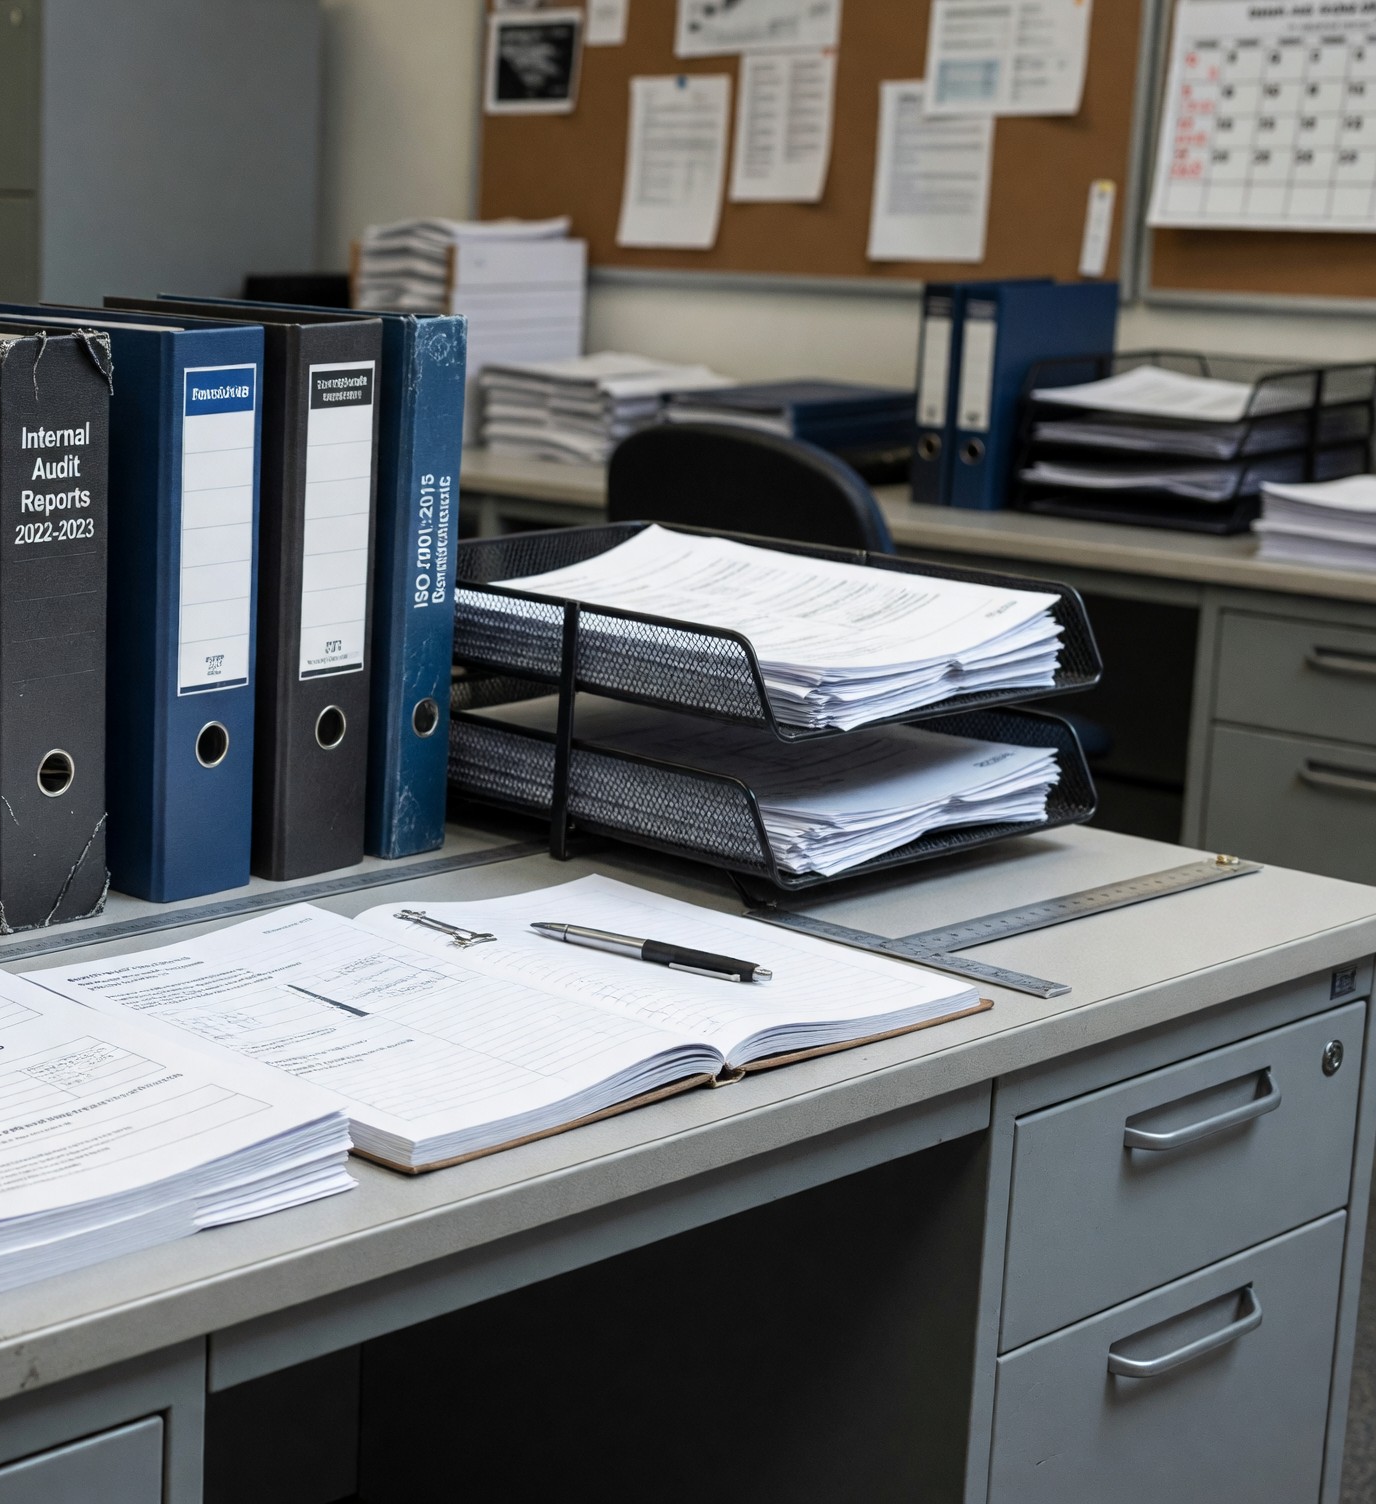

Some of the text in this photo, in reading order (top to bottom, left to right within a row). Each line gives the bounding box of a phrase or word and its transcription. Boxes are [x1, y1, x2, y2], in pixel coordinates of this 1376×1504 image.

[21, 422, 90, 450] Internal
[32, 455, 81, 481] Audit
[21, 487, 91, 517] Reports
[14, 518, 95, 545] 2022-2023
[414, 573, 431, 609] ISO
